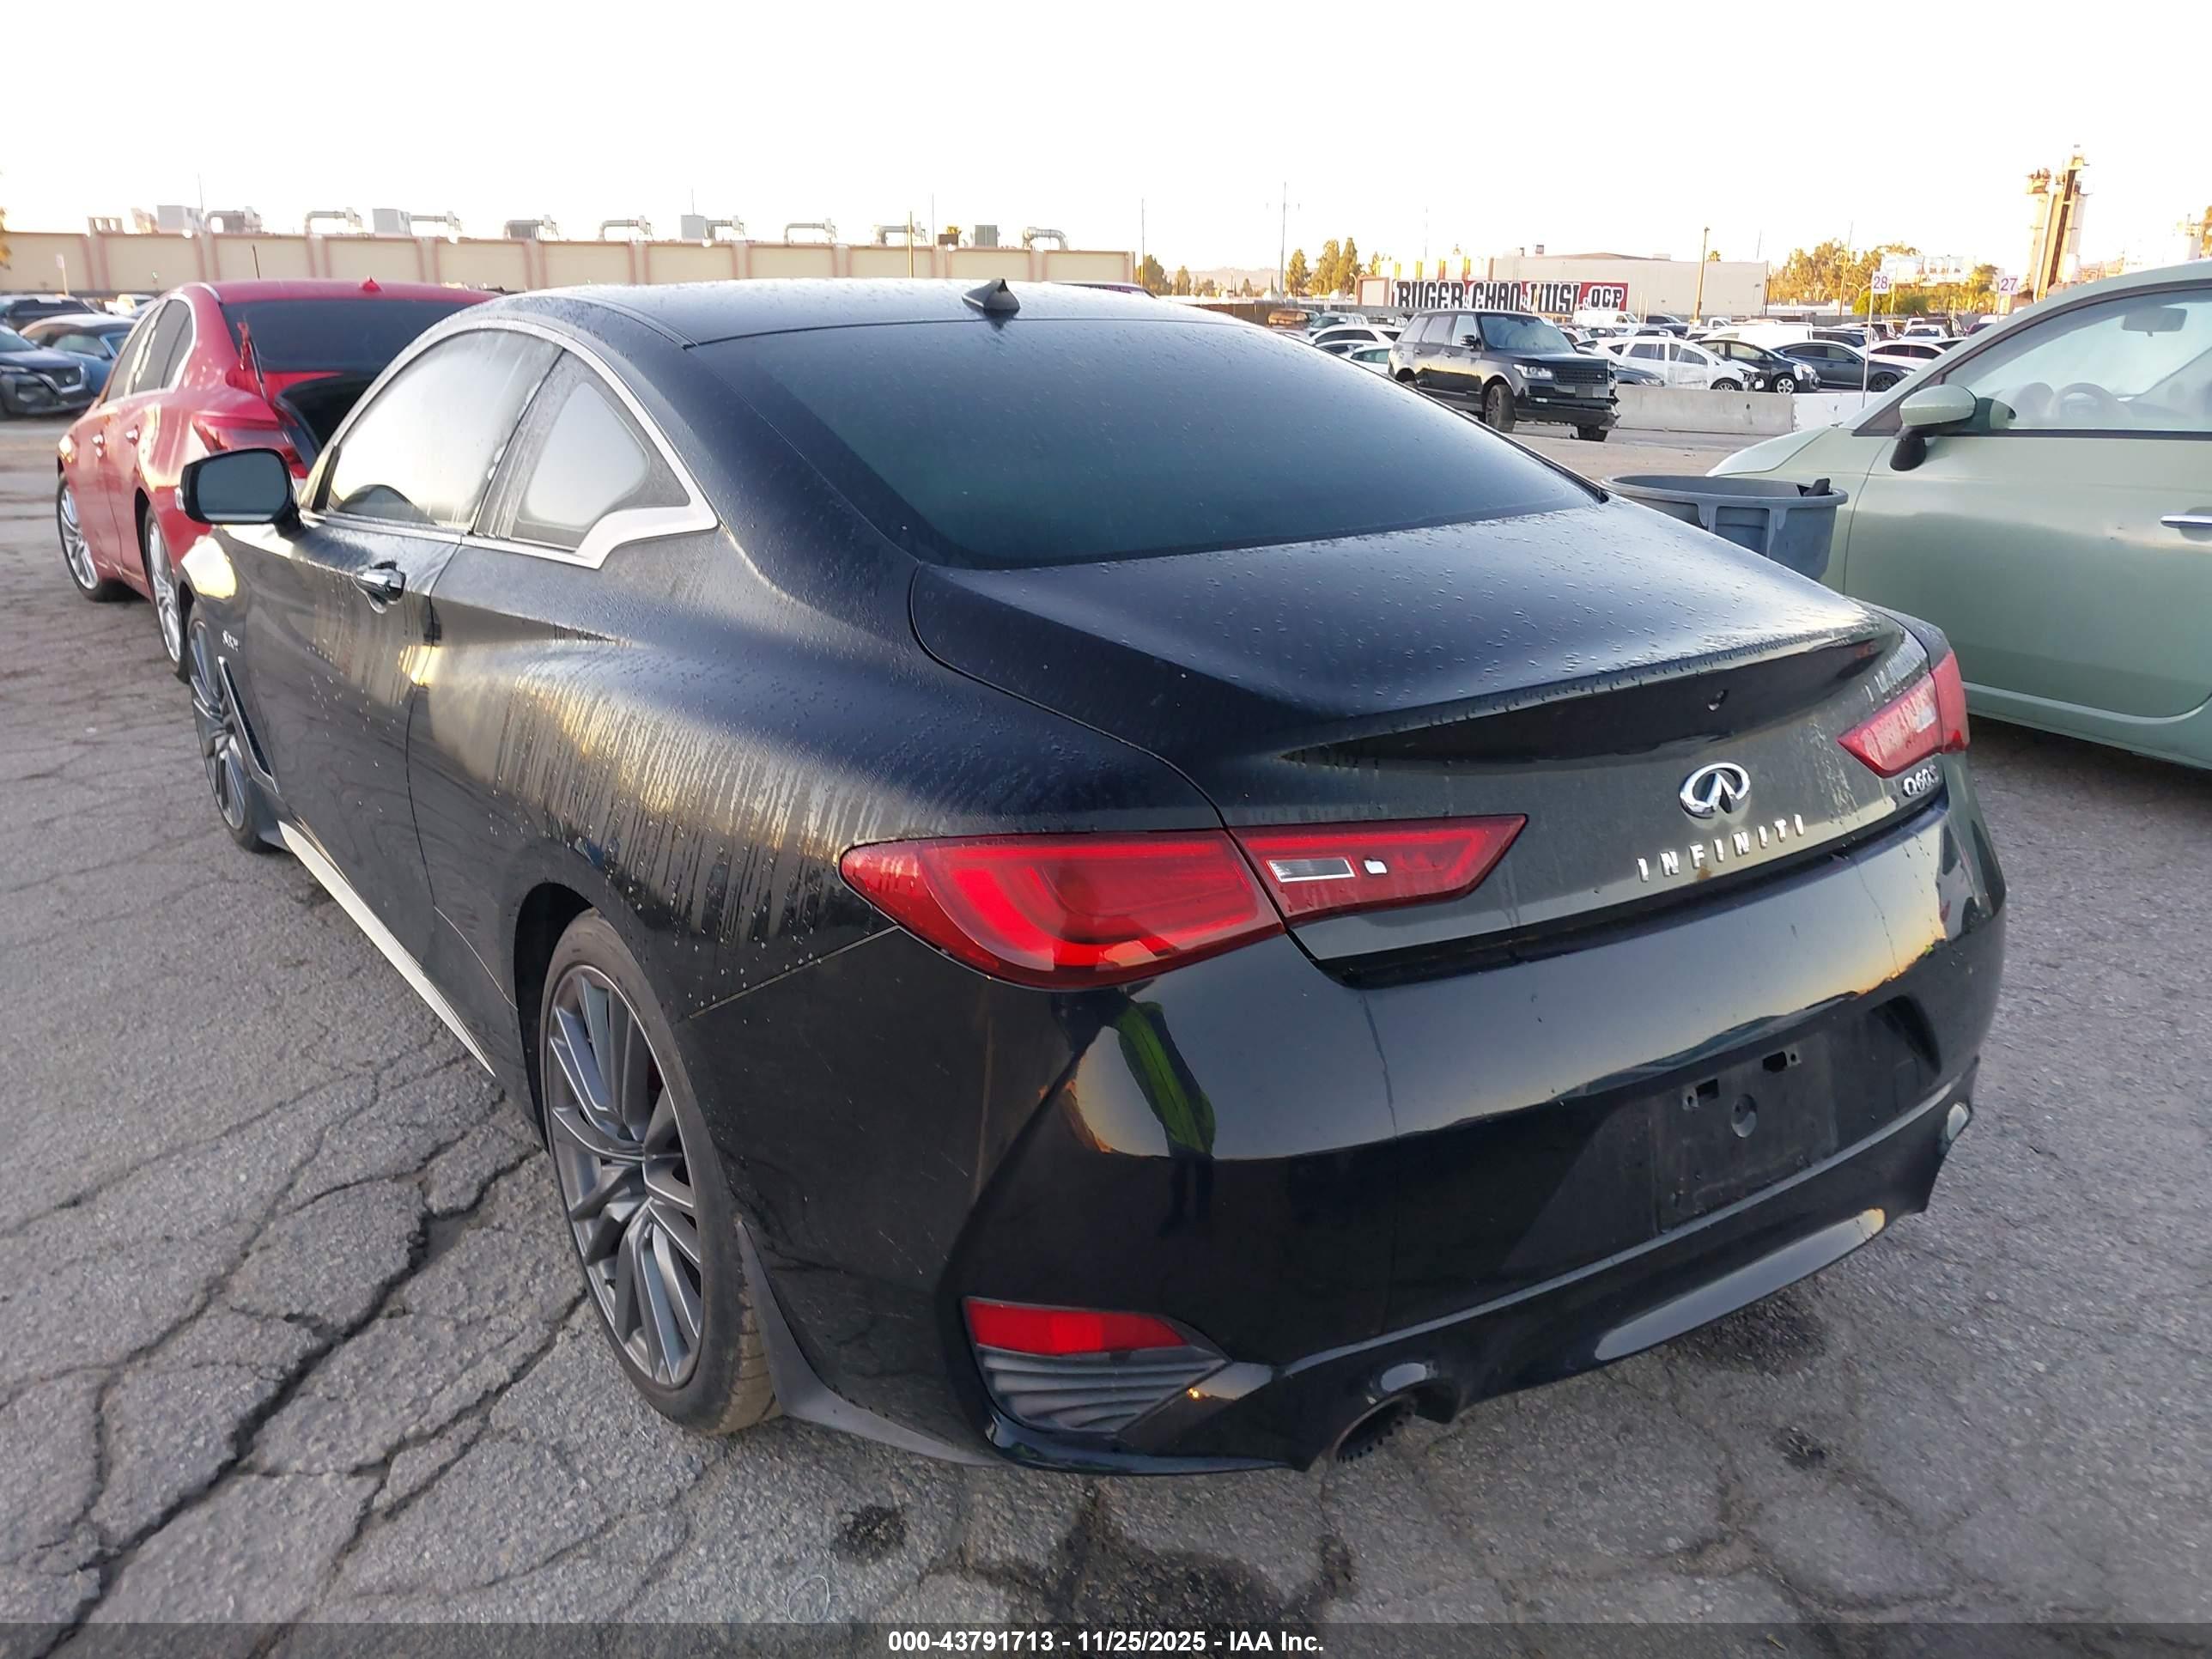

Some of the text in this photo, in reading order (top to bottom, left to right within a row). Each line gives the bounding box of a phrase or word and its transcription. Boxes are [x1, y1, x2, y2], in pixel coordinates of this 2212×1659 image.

[1873, 276, 1888, 289] 28
[2000, 277, 2018, 291] 27
[1591, 288, 1623, 308] OCP
[1637, 813, 1804, 882] INFINITI
